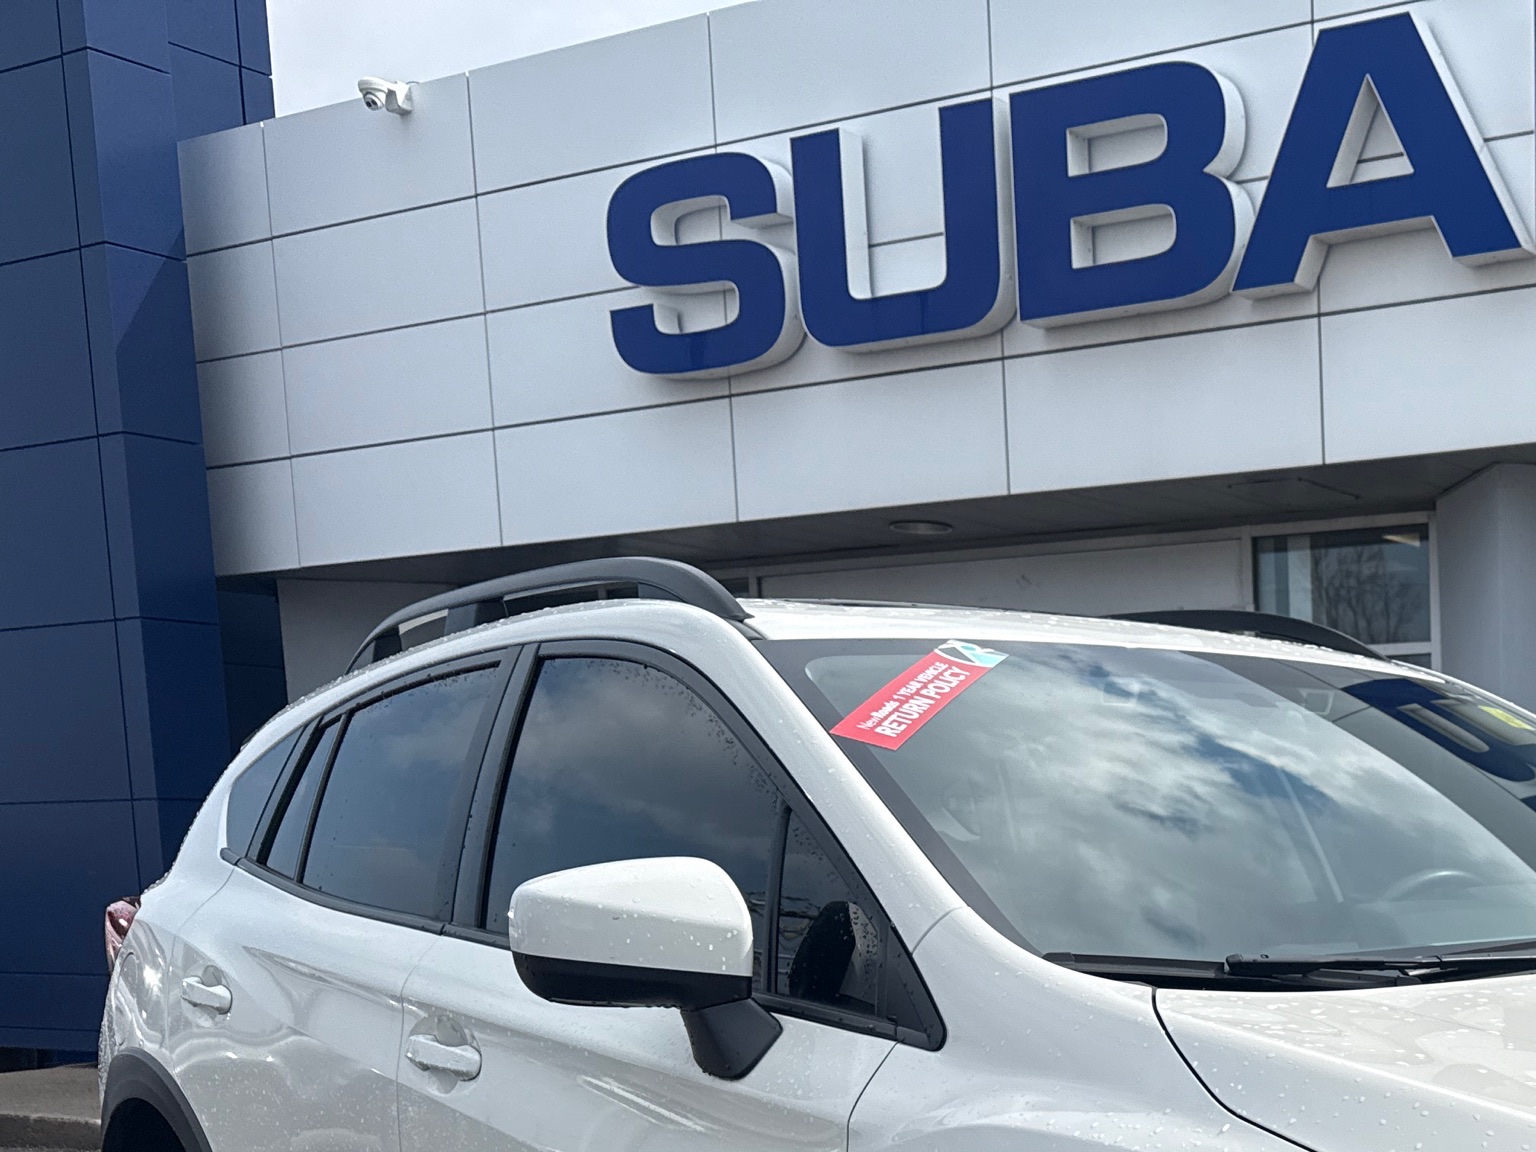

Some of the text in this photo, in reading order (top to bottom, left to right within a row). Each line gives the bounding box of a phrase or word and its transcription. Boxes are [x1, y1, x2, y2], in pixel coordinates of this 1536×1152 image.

[856, 700, 900, 730] NewRoads
[896, 680, 924, 697] YEAR
[914, 661, 949, 684] VEHICLE
[874, 665, 971, 738] RETURN POLICY
